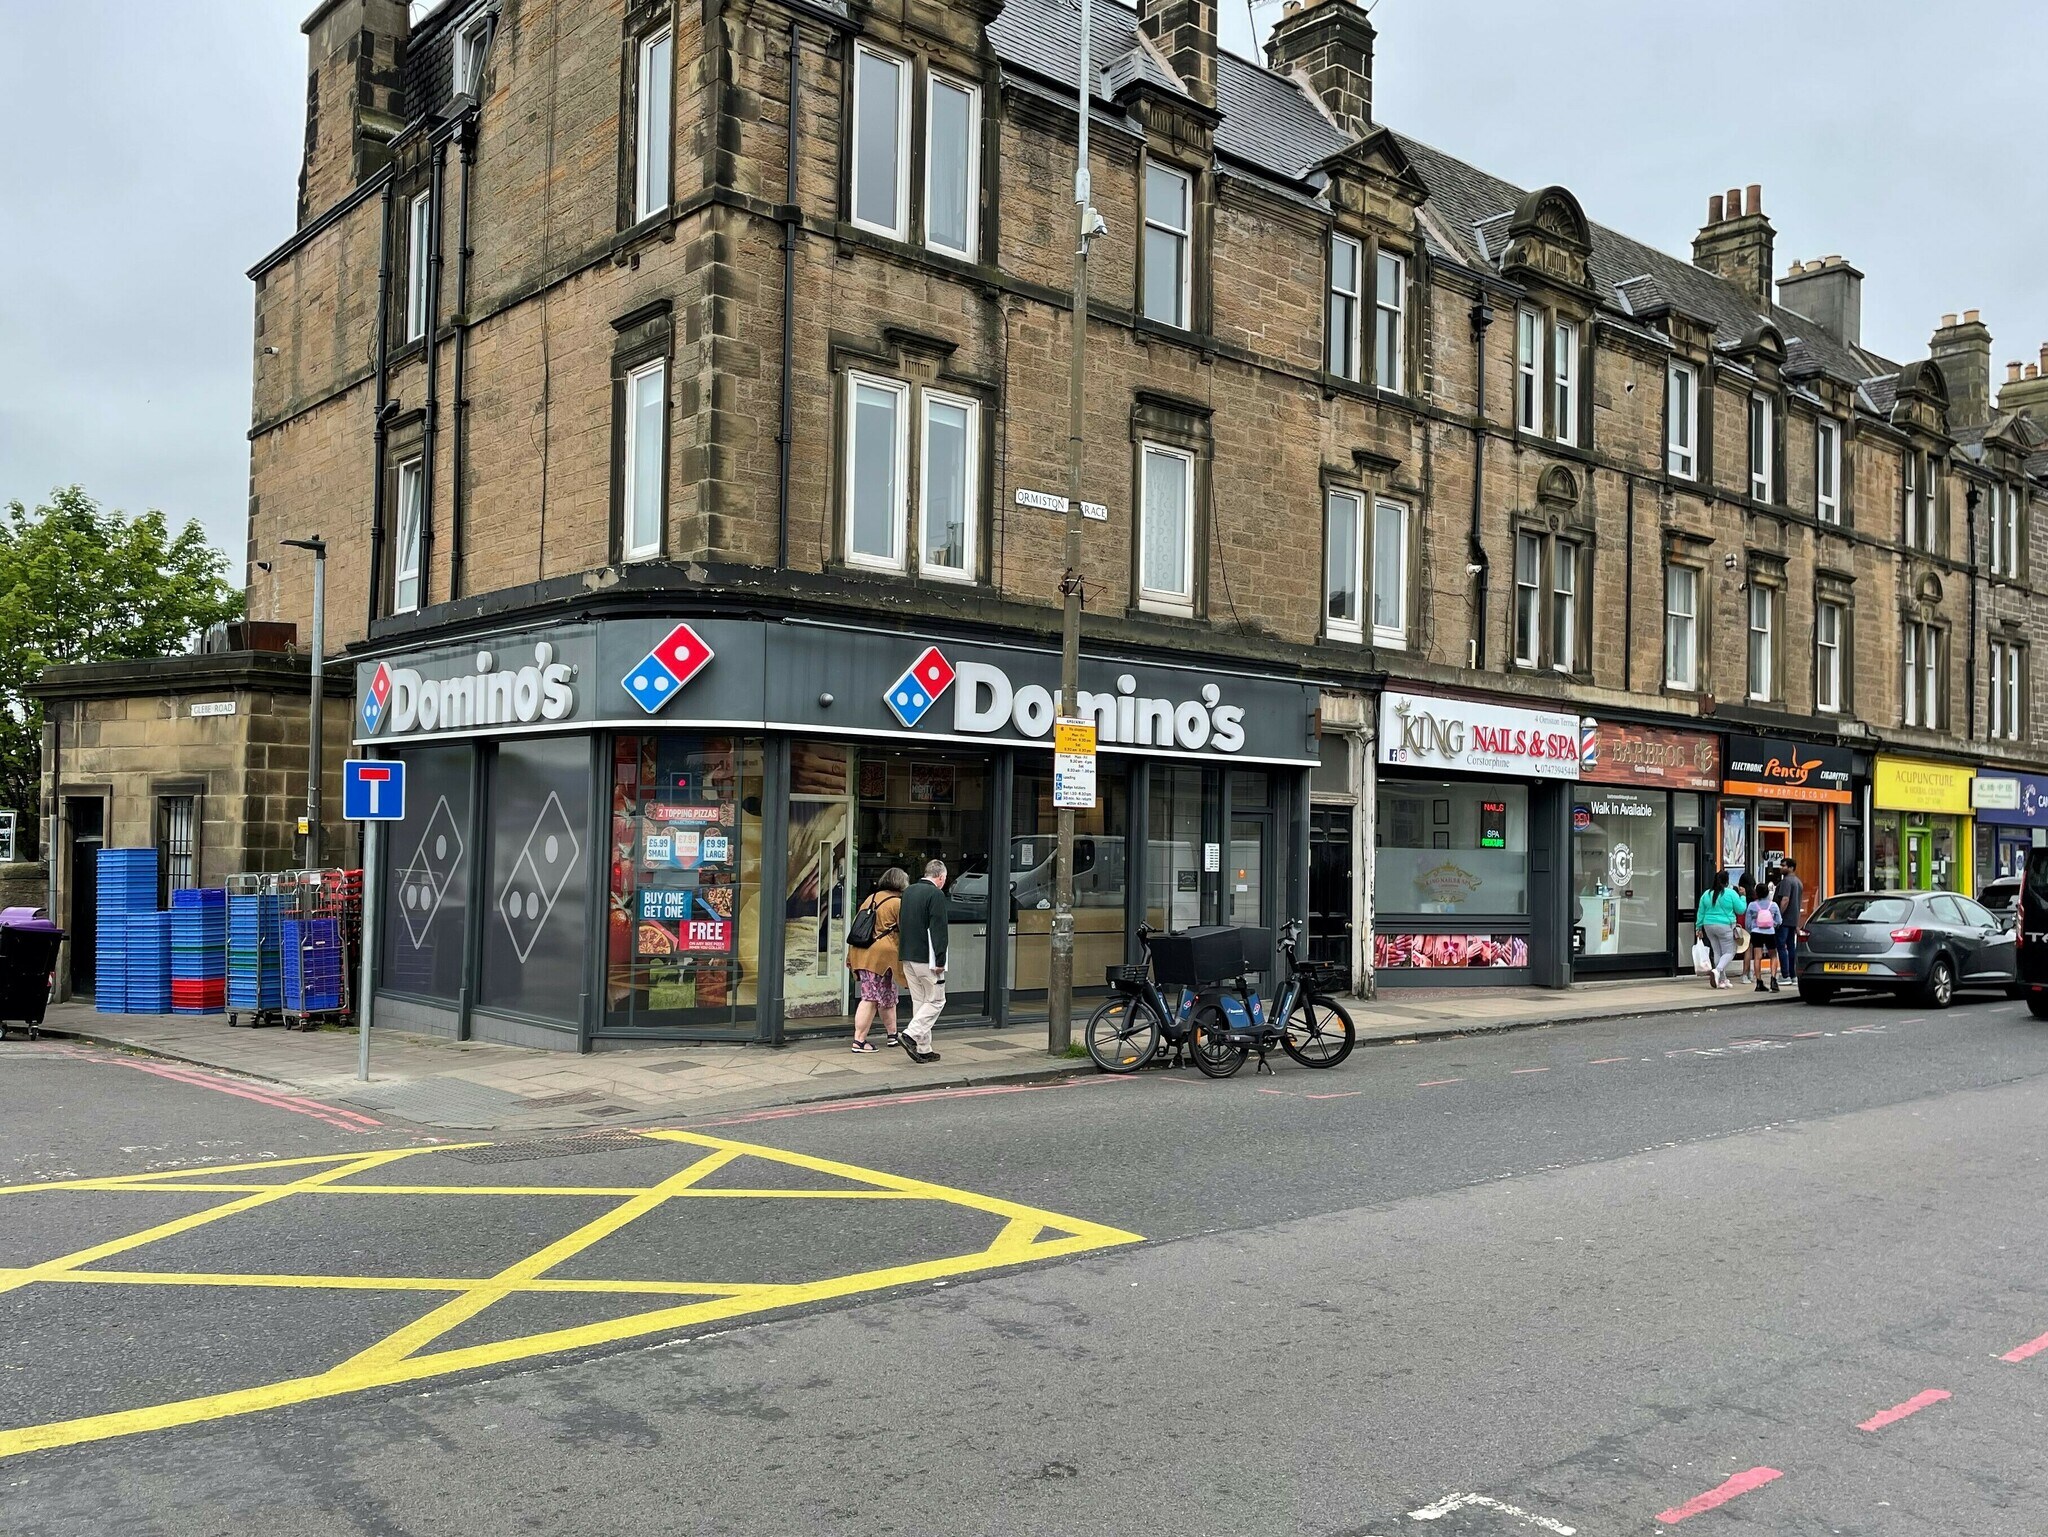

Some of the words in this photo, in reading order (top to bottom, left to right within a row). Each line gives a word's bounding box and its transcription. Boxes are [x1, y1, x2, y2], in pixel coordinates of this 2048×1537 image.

[1018, 491, 1065, 510] ORMISTON
[1080, 505, 1106, 518] RACE
[391, 642, 574, 732] Domino's
[214, 703, 233, 713] ROAD
[1399, 710, 1466, 759] KING
[1472, 725, 1527, 755] NAILS
[1529, 730, 1546, 758] &
[1547, 733, 1579, 761] SPA
[1612, 739, 1686, 768] BARBROS
[1466, 754, 1510, 769] Corstorphine
[1731, 761, 1764, 773] ELECTRONIC
[1820, 770, 1849, 781] CIGARETTES
[1895, 769, 1953, 787] ACUPUNCTURE
[658, 809, 664, 818] 2
[665, 809, 693, 818] TOPPING
[693, 809, 718, 819] PIZZAS
[1484, 803, 1504, 812] NAILS
[1590, 801, 1610, 815] Walk
[1611, 802, 1619, 815] In
[1620, 803, 1653, 817] Available
[1574, 813, 1590, 826] PEN
[678, 835, 697, 844] £7.99
[1486, 829, 1500, 838] SPA
[649, 838, 668, 848] £5.99
[706, 839, 726, 849] £9.99
[648, 849, 669, 858] SMALL
[705, 850, 726, 859] LARGE
[644, 891, 664, 905] BUY
[665, 892, 684, 905] ONE
[643, 905, 662, 918] GET
[664, 906, 683, 918] ONE
[688, 922, 724, 941] FREE
